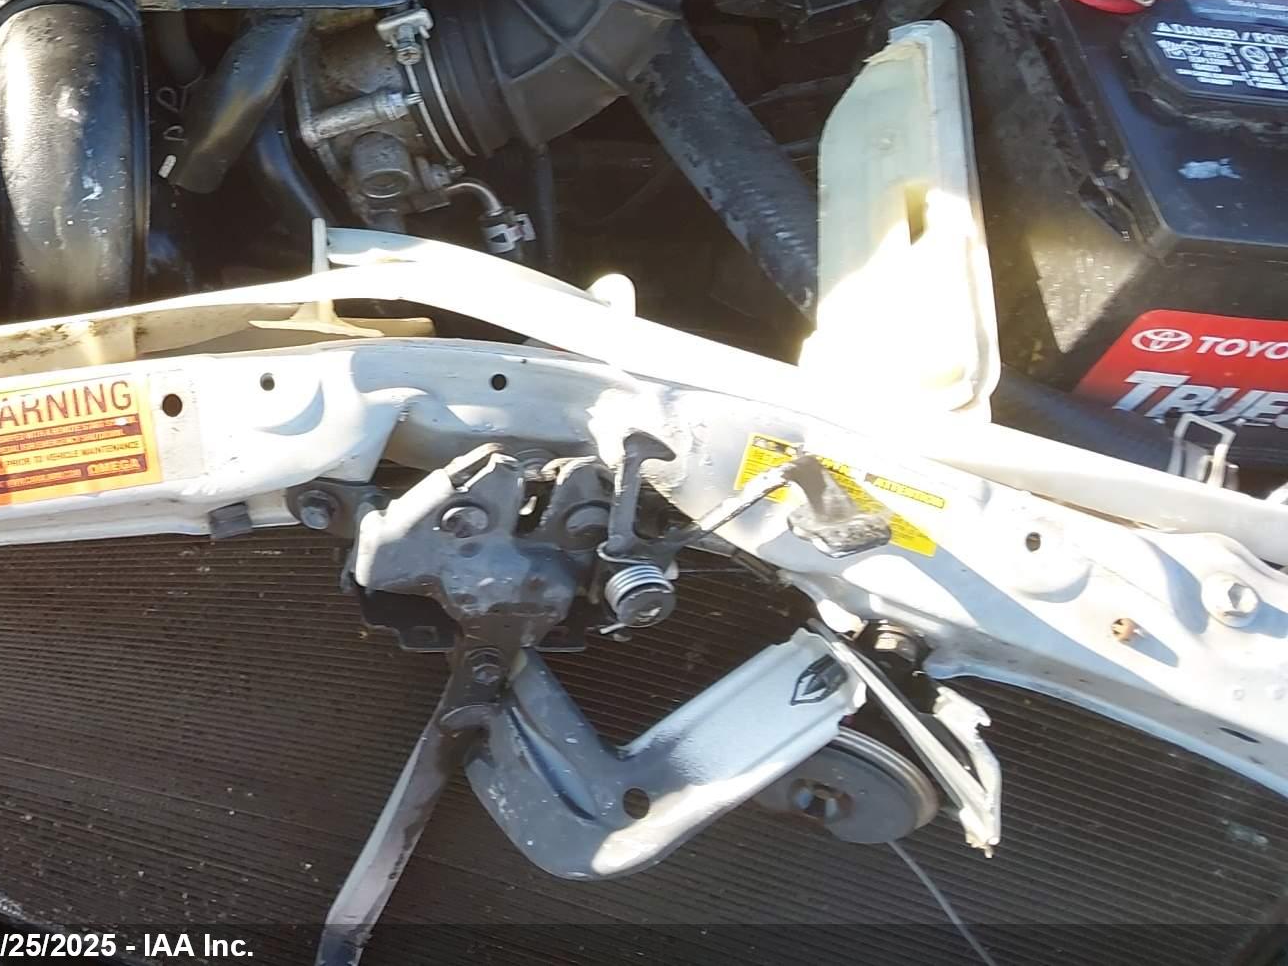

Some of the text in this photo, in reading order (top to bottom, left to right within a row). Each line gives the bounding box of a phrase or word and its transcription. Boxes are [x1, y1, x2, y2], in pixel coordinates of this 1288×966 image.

[1197, 336, 1288, 359] TOYO
[1112, 370, 1288, 428] TRUE
[81, 440, 140, 456] MAINTENANCE
[87, 457, 142, 476] OMEGA
